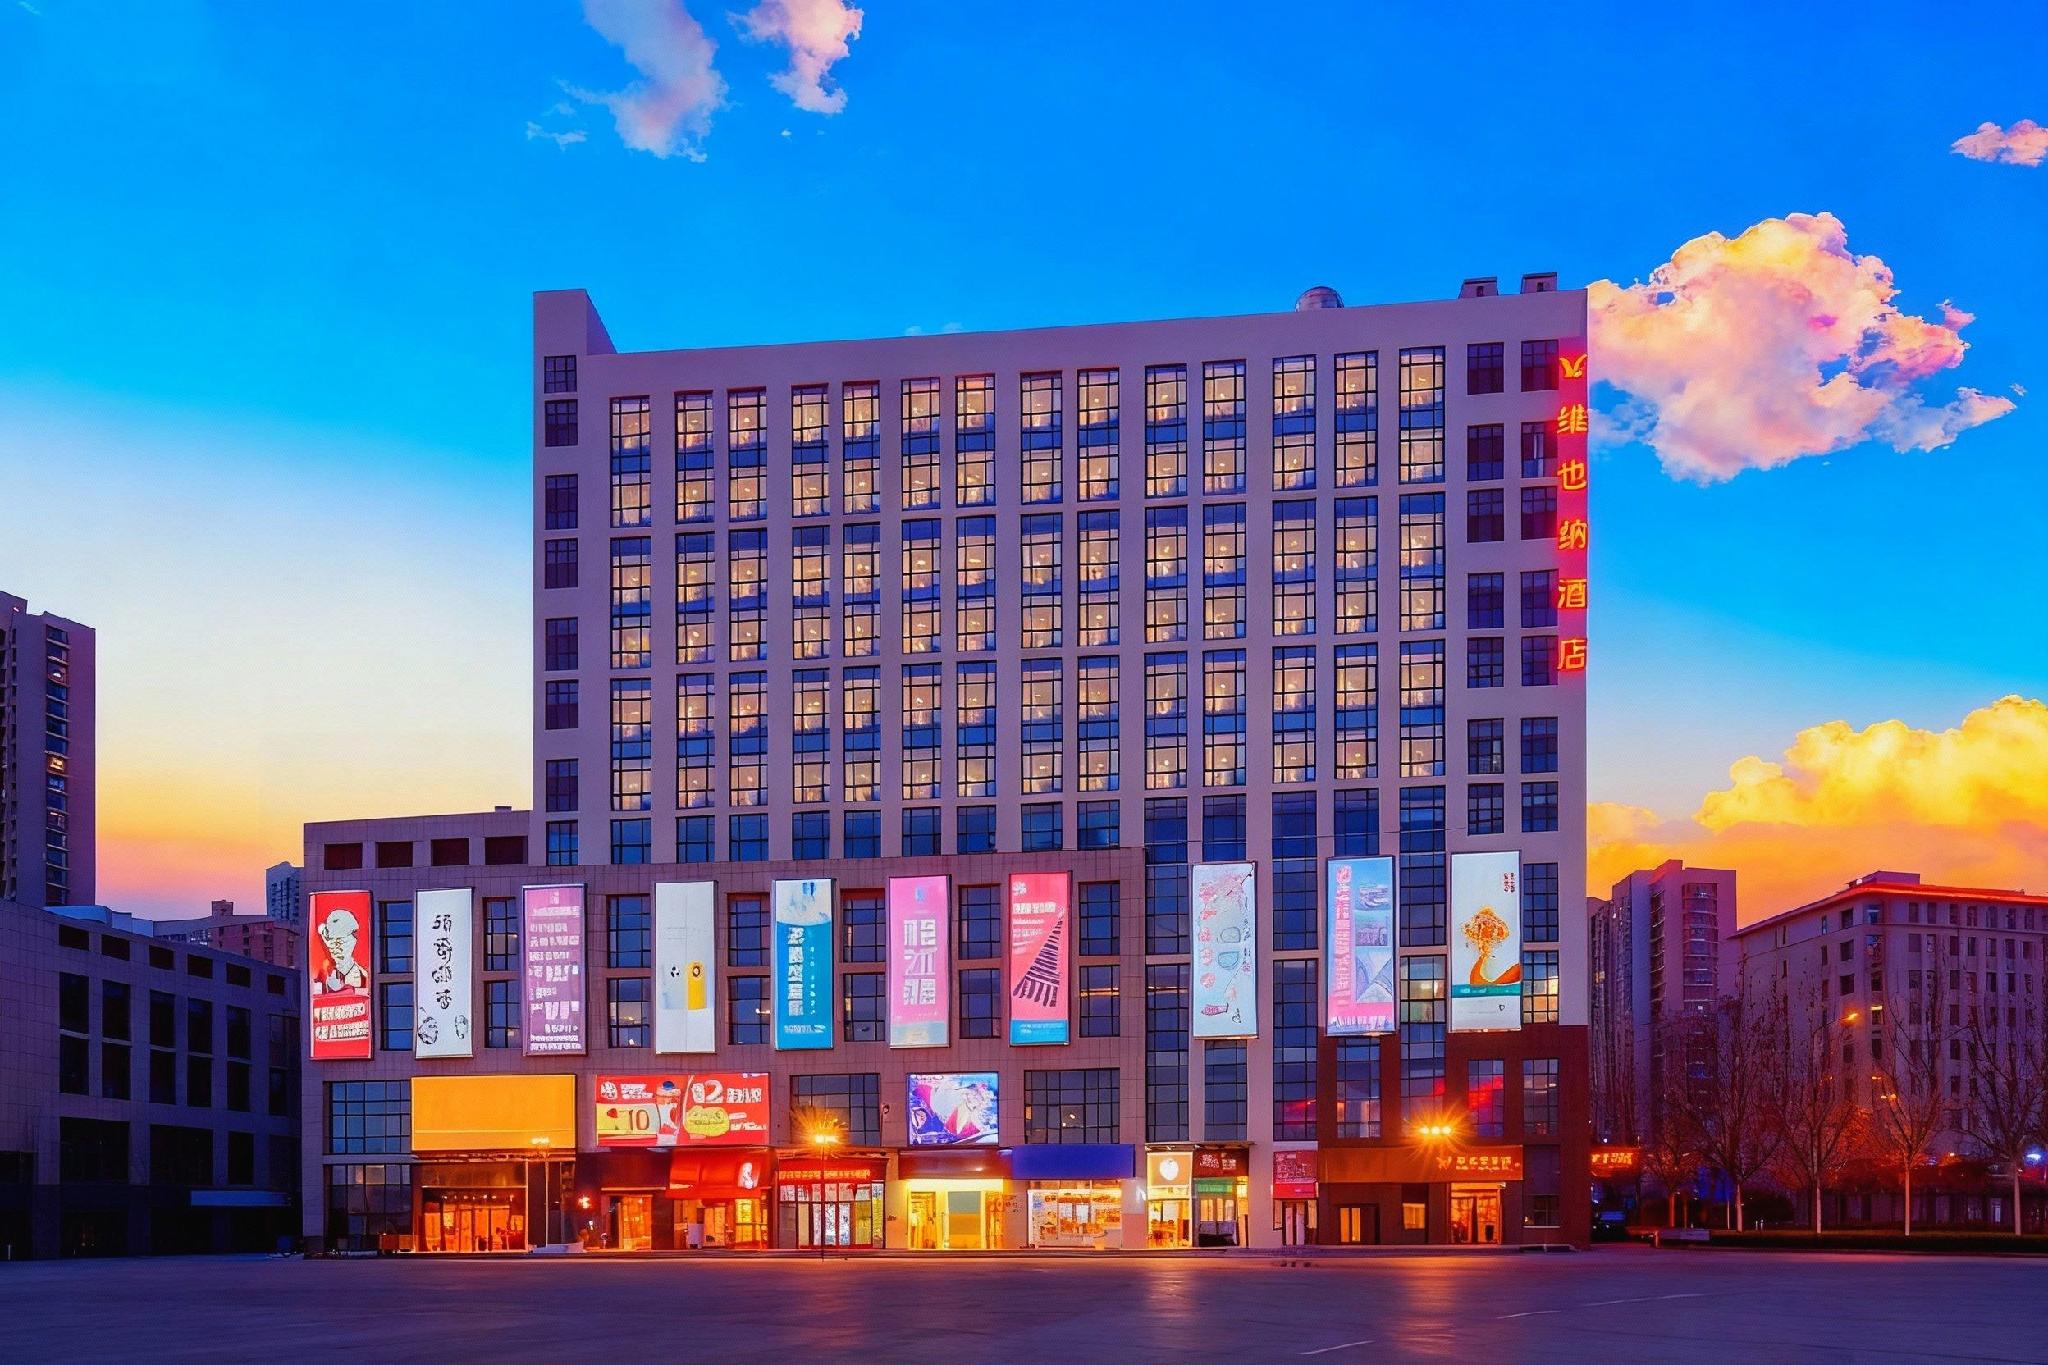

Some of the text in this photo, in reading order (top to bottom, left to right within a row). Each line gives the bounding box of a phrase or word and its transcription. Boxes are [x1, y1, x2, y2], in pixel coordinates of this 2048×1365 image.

[1557, 405, 1588, 671] 维也纳酒店
